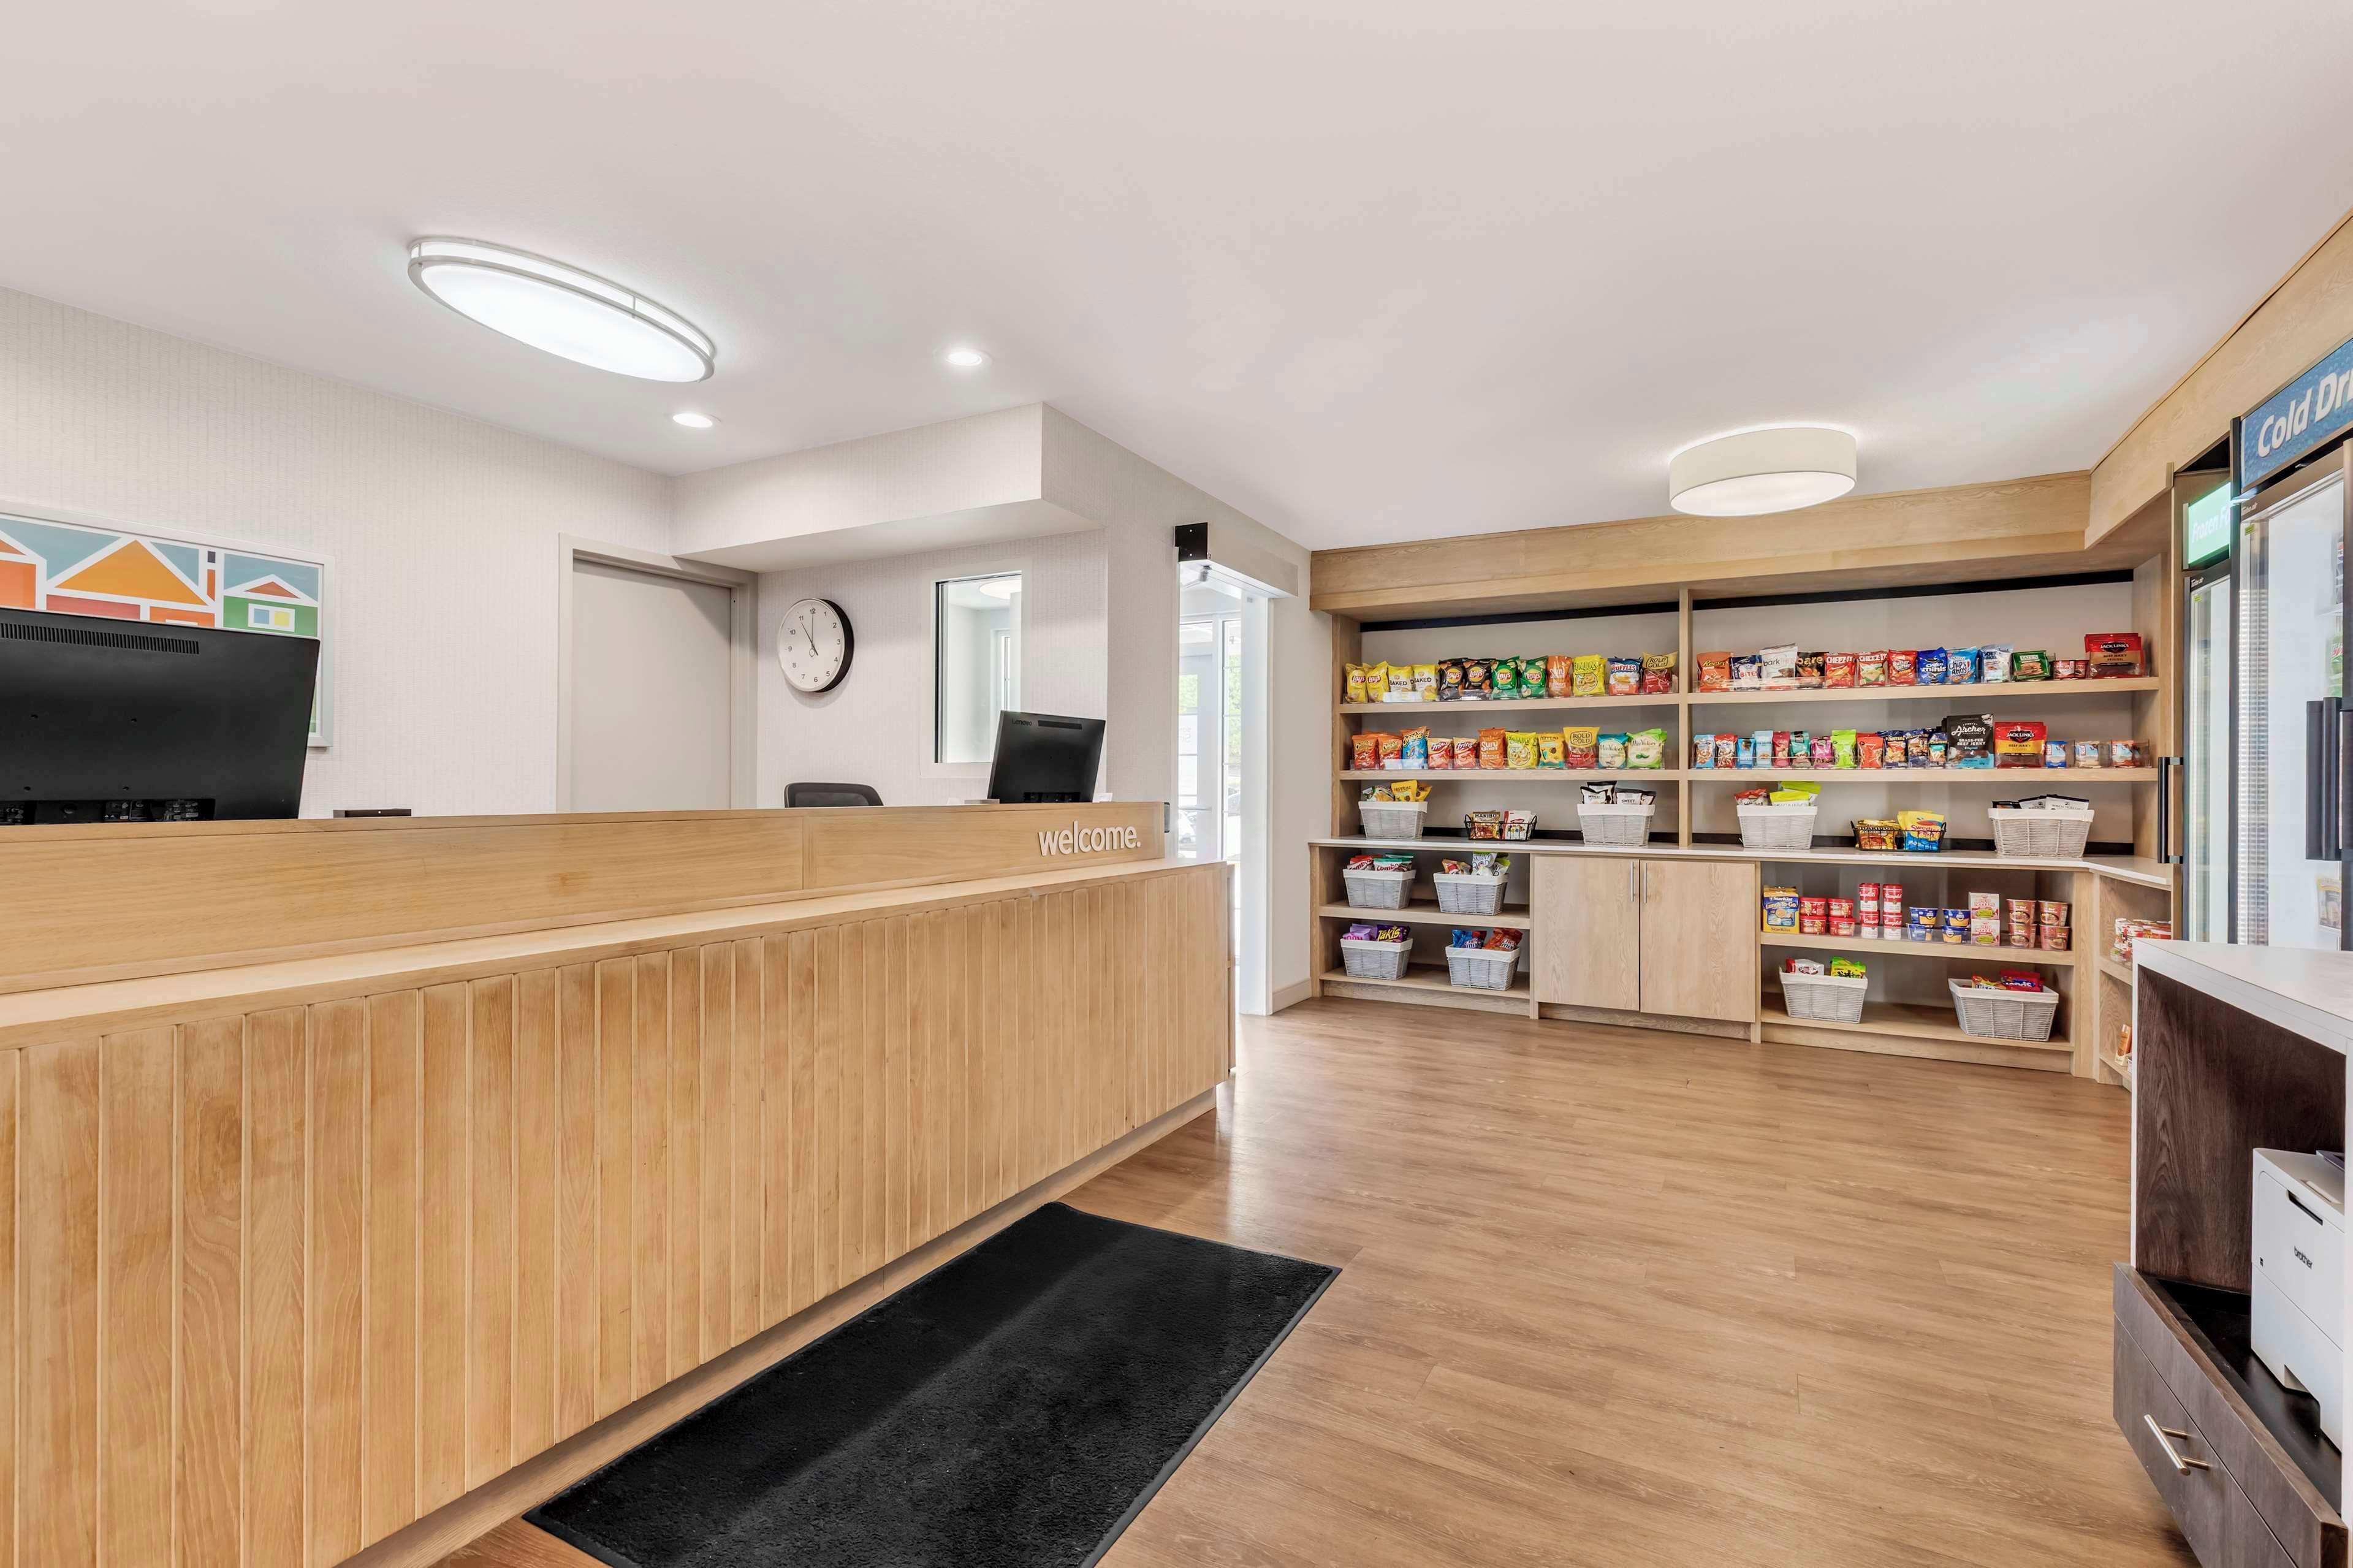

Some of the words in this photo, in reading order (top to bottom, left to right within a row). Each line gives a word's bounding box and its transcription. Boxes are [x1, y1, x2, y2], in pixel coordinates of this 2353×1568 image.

[2258, 387, 2313, 458] Cold
[1949, 661, 1966, 669] Chips
[1952, 725, 1986, 736] Archer
[1037, 820, 1141, 856] welcome.
[2294, 1246, 2313, 1269] brother
